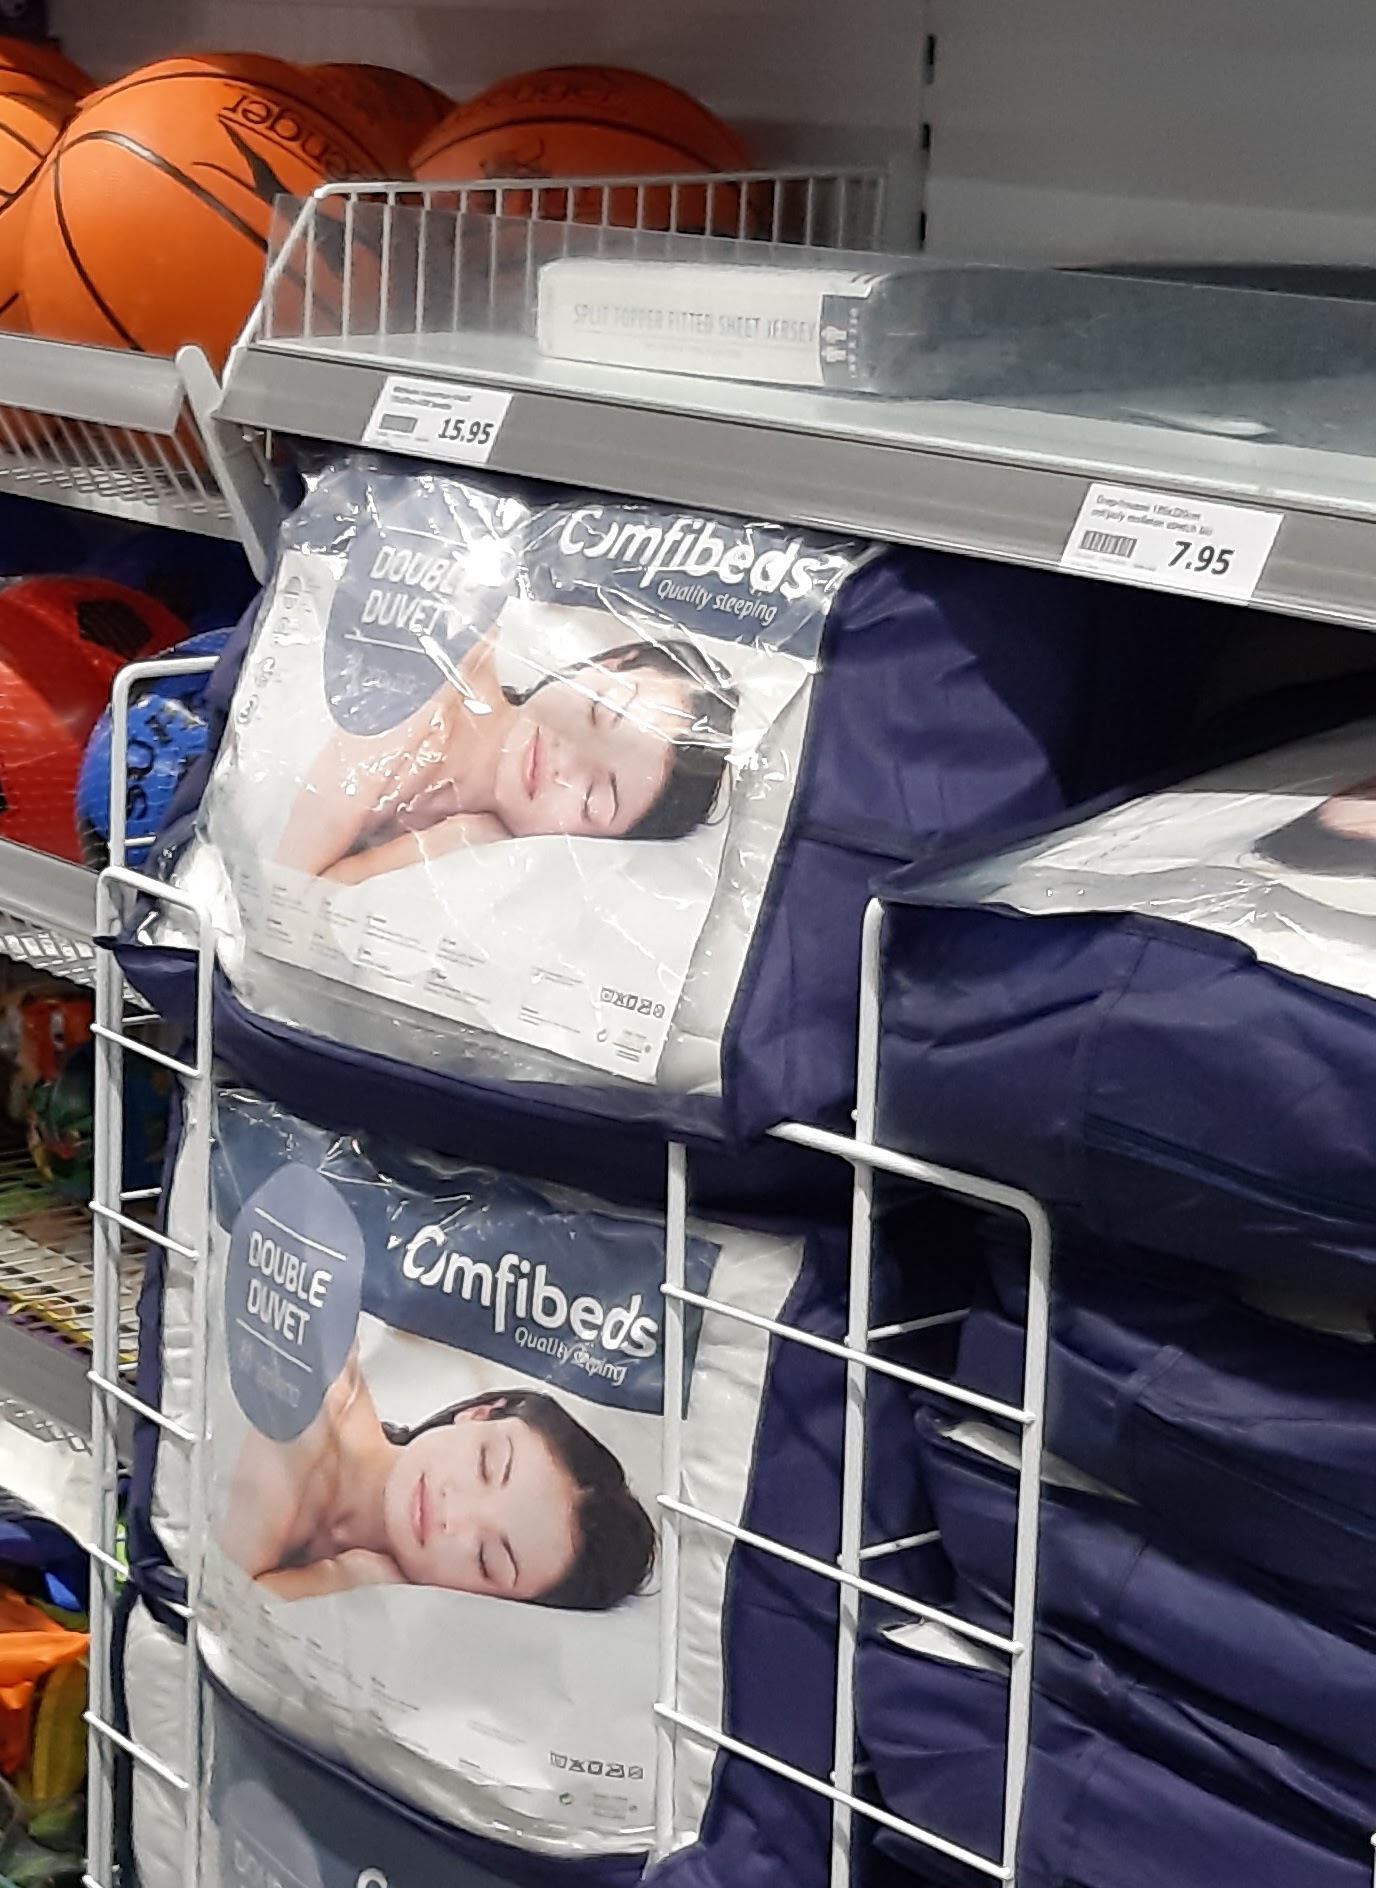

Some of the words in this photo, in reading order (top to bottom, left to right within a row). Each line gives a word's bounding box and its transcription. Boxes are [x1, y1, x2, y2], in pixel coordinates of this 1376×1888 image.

[573, 303, 609, 326] SPLIT
[668, 310, 714, 336] FITTED
[718, 313, 761, 339] SHEET
[766, 319, 817, 343] JERSEY
[437, 417, 495, 445] 15.95
[559, 508, 822, 600] Comfibeds
[1167, 540, 1236, 576] 7.95
[656, 577, 715, 609] Quality
[715, 590, 778, 627] sleeping
[247, 1229, 334, 1309] DOUBLE
[402, 1224, 659, 1358] Comfibeds
[246, 1277, 311, 1346] DUVET
[514, 1326, 573, 1365] Quality
[572, 1345, 629, 1387] eping
